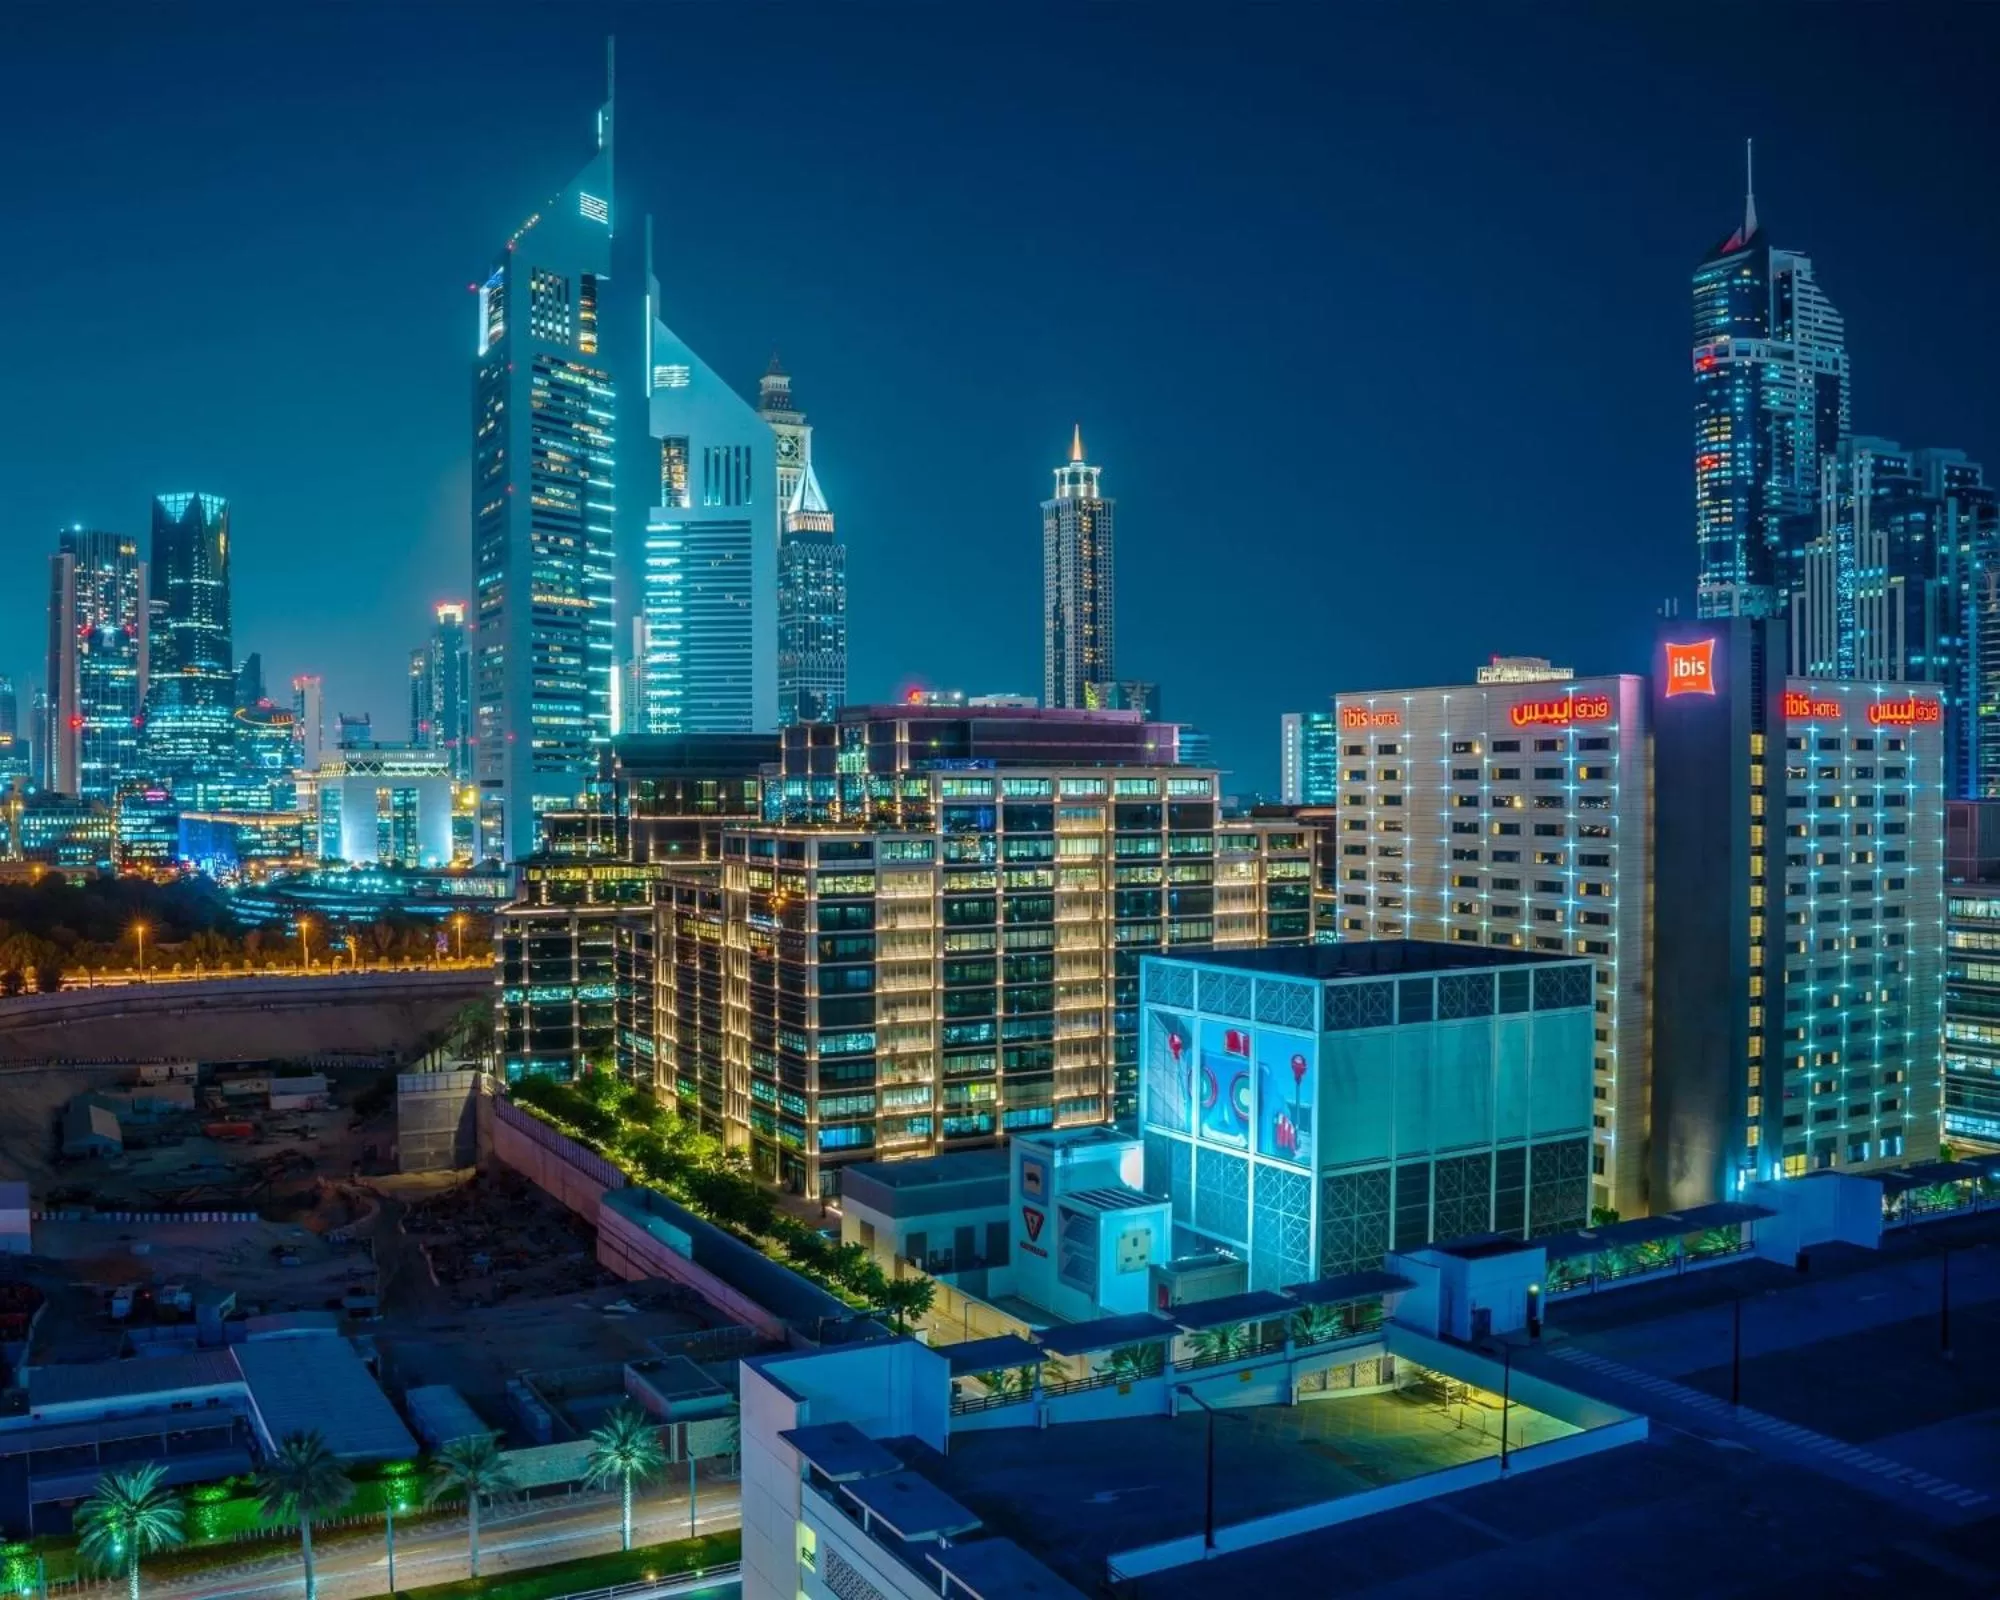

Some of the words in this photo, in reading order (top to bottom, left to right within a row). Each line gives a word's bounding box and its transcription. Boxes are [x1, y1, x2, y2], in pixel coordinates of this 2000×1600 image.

[1673, 655, 1706, 678] ibis
[1575, 696, 1608, 718] فندق
[1785, 694, 1809, 716] ibis
[1812, 703, 1841, 717] HOTEL
[1343, 707, 1369, 728] ibis
[1370, 711, 1401, 726] HOTEL
